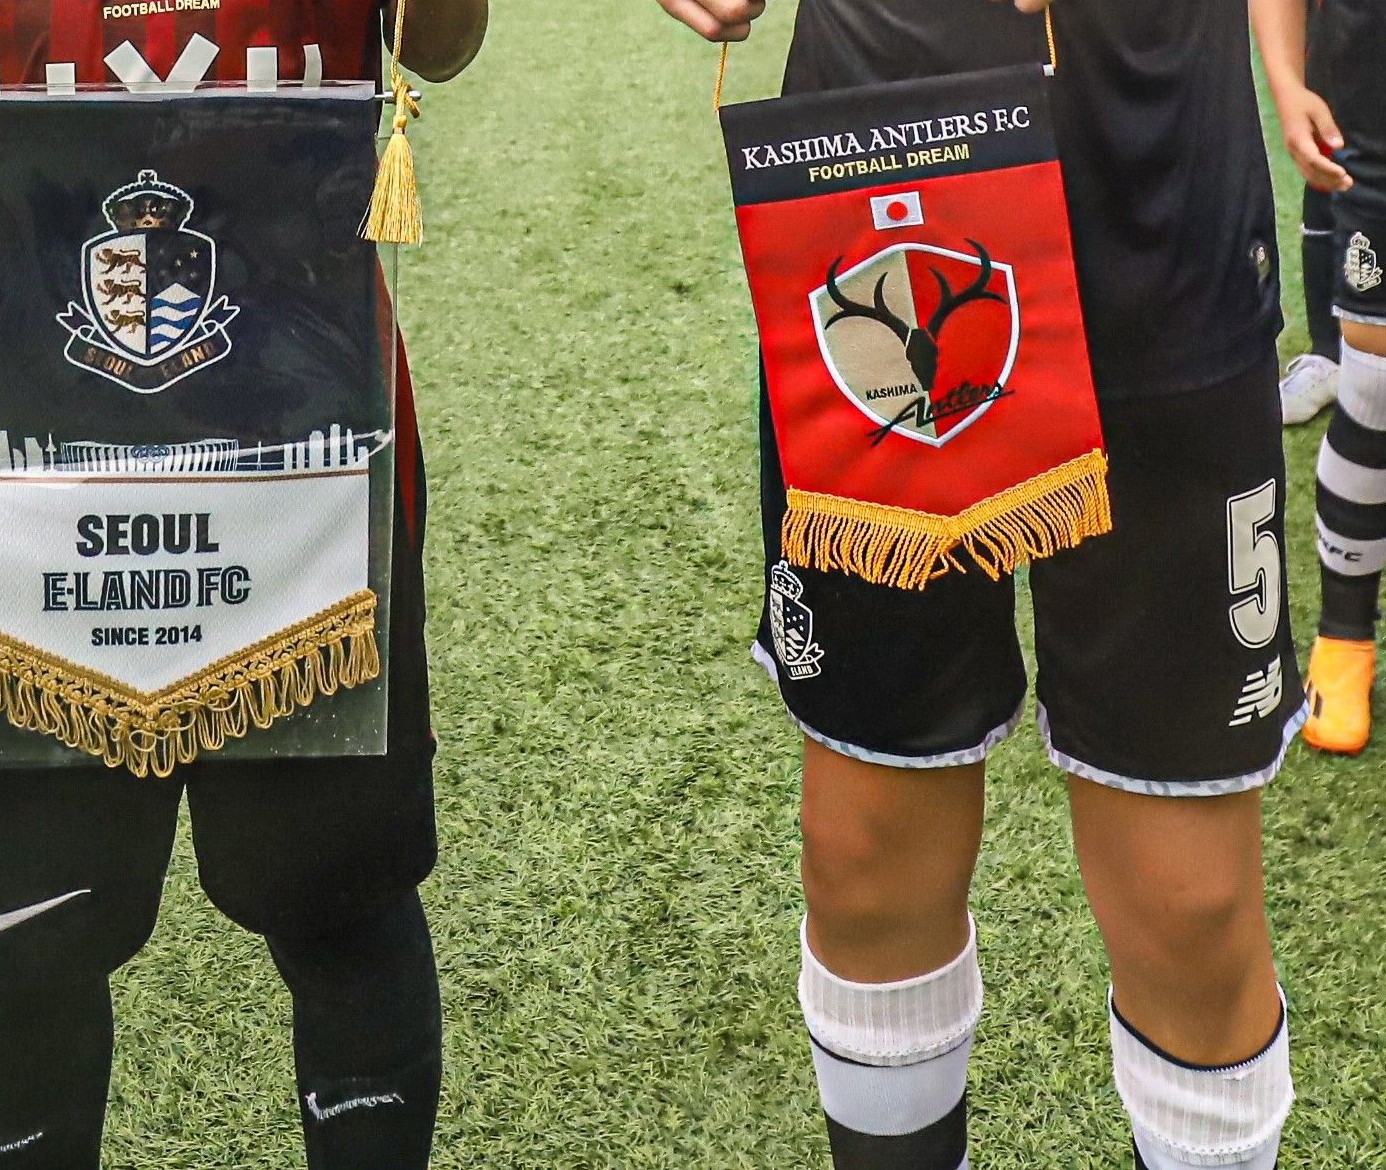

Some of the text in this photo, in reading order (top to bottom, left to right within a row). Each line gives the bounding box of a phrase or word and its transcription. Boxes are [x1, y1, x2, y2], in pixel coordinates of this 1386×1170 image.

[103, 0, 175, 20] FOOTBALL
[742, 105, 1031, 171] KASHIMA ANTLERS F.C
[808, 142, 971, 183] FOOTBALL DREAM
[865, 383, 918, 401] KASHIMA
[76, 513, 220, 558] SEOUL
[1226, 477, 1283, 650] 5
[196, 565, 251, 608] FC
[91, 624, 203, 647] SINCE 2014
